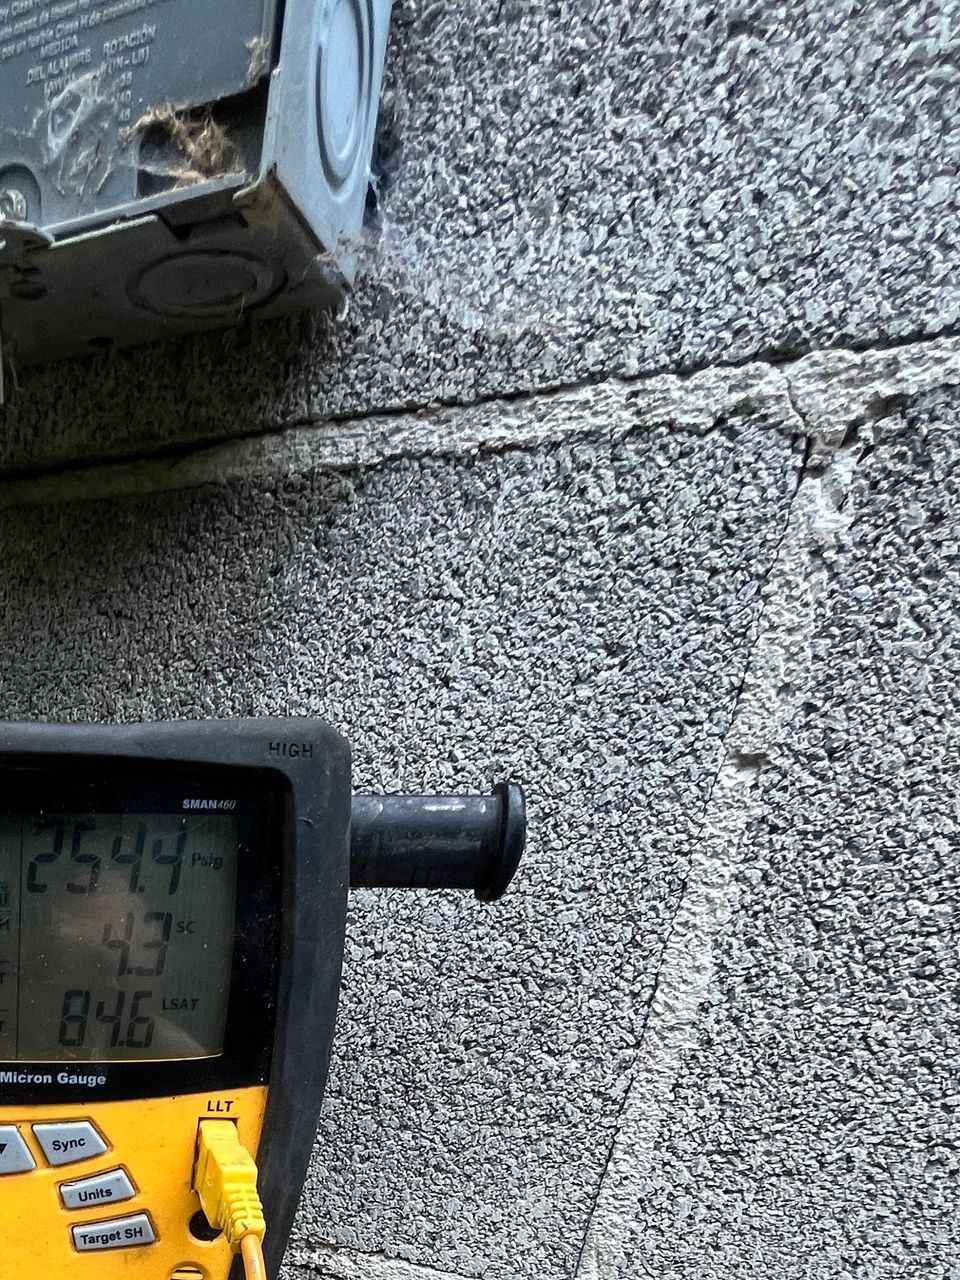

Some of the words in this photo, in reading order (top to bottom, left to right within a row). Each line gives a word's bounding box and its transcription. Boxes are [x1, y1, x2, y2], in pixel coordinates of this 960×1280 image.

[269, 741, 313, 758] HIGH
[182, 798, 236, 810] SMAN460
[191, 852, 224, 870] Psig
[176, 920, 197, 934] SC
[161, 998, 200, 1011] LSAT
[0, 1071, 52, 1084] Micron
[57, 1072, 107, 1087] Gauge
[206, 1100, 234, 1112] LLT
[52, 1136, 86, 1152] Sync
[78, 1186, 113, 1203] Units
[80, 1229, 122, 1246] Target
[124, 1226, 143, 1240] SH
